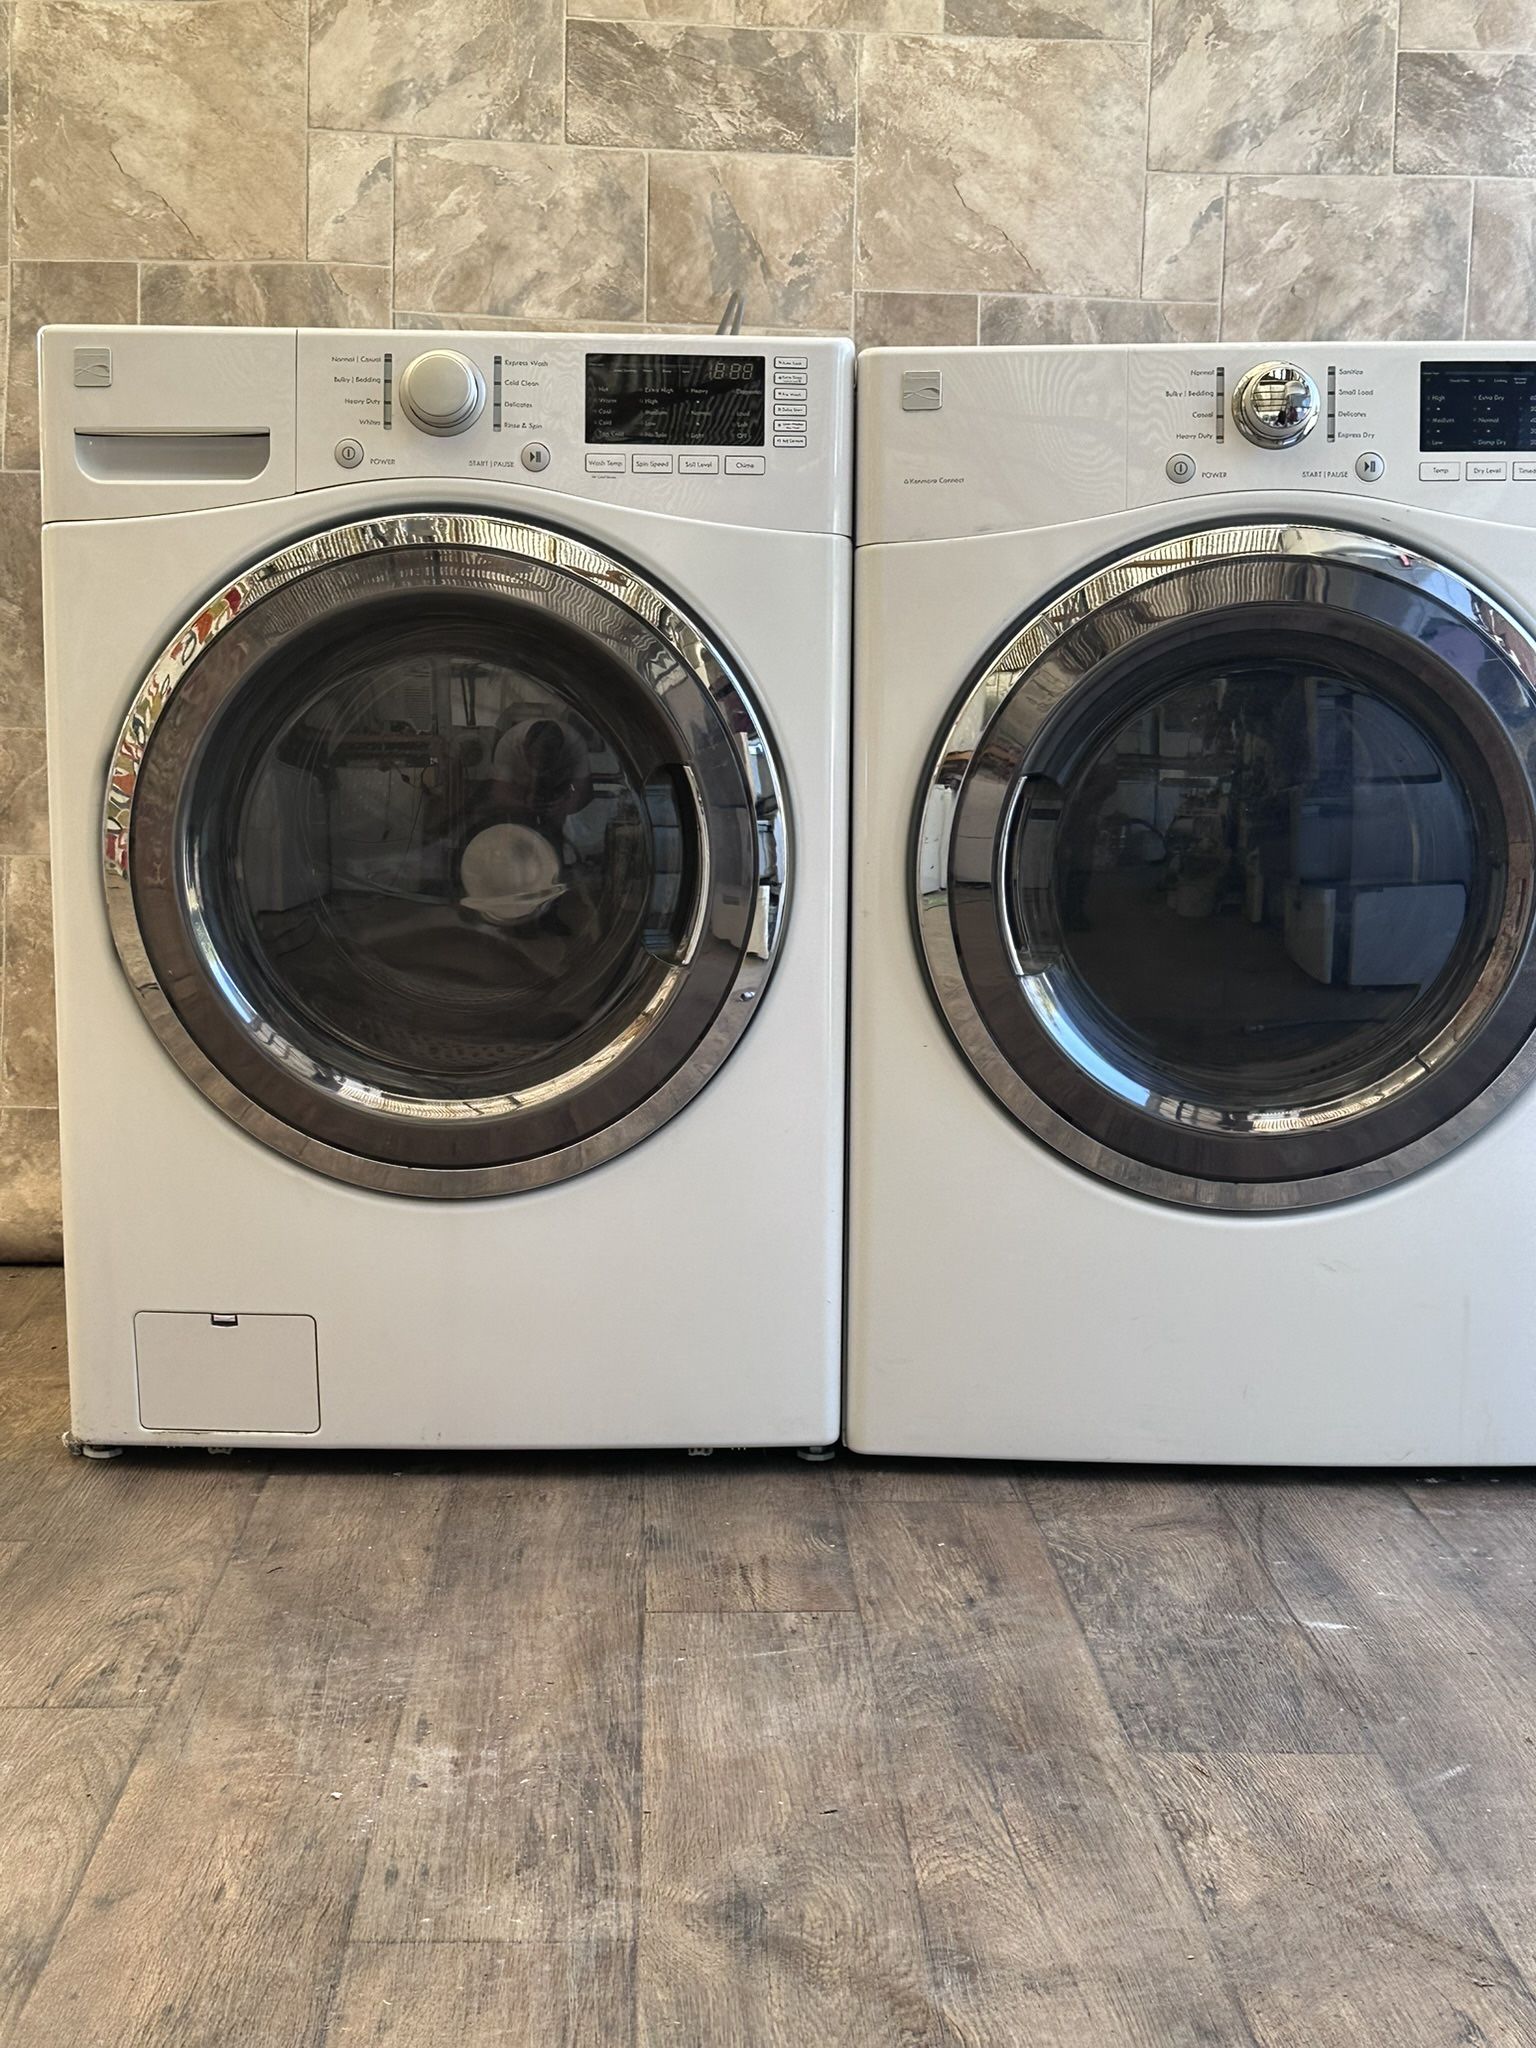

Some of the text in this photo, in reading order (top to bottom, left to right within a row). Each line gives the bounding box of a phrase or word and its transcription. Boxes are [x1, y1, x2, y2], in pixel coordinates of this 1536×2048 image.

[504, 359, 528, 367] Express
[333, 376, 381, 385] Bulky Bedding
[504, 379, 539, 387] Cold Clean
[1165, 390, 1214, 398] Bulky Bedding
[1191, 411, 1214, 419] Casual
[528, 422, 544, 432] Spin
[1175, 432, 1214, 441] Heavy Duty
[1337, 431, 1376, 440] Express Dry
[369, 458, 396, 466] POWER
[468, 460, 489, 468] START
[606, 460, 623, 468] Temp
[635, 460, 670, 469] Spin Speed
[1432, 466, 1449, 475] Temp
[1473, 467, 1485, 475] Dry
[1302, 471, 1349, 479] START PAUSE
